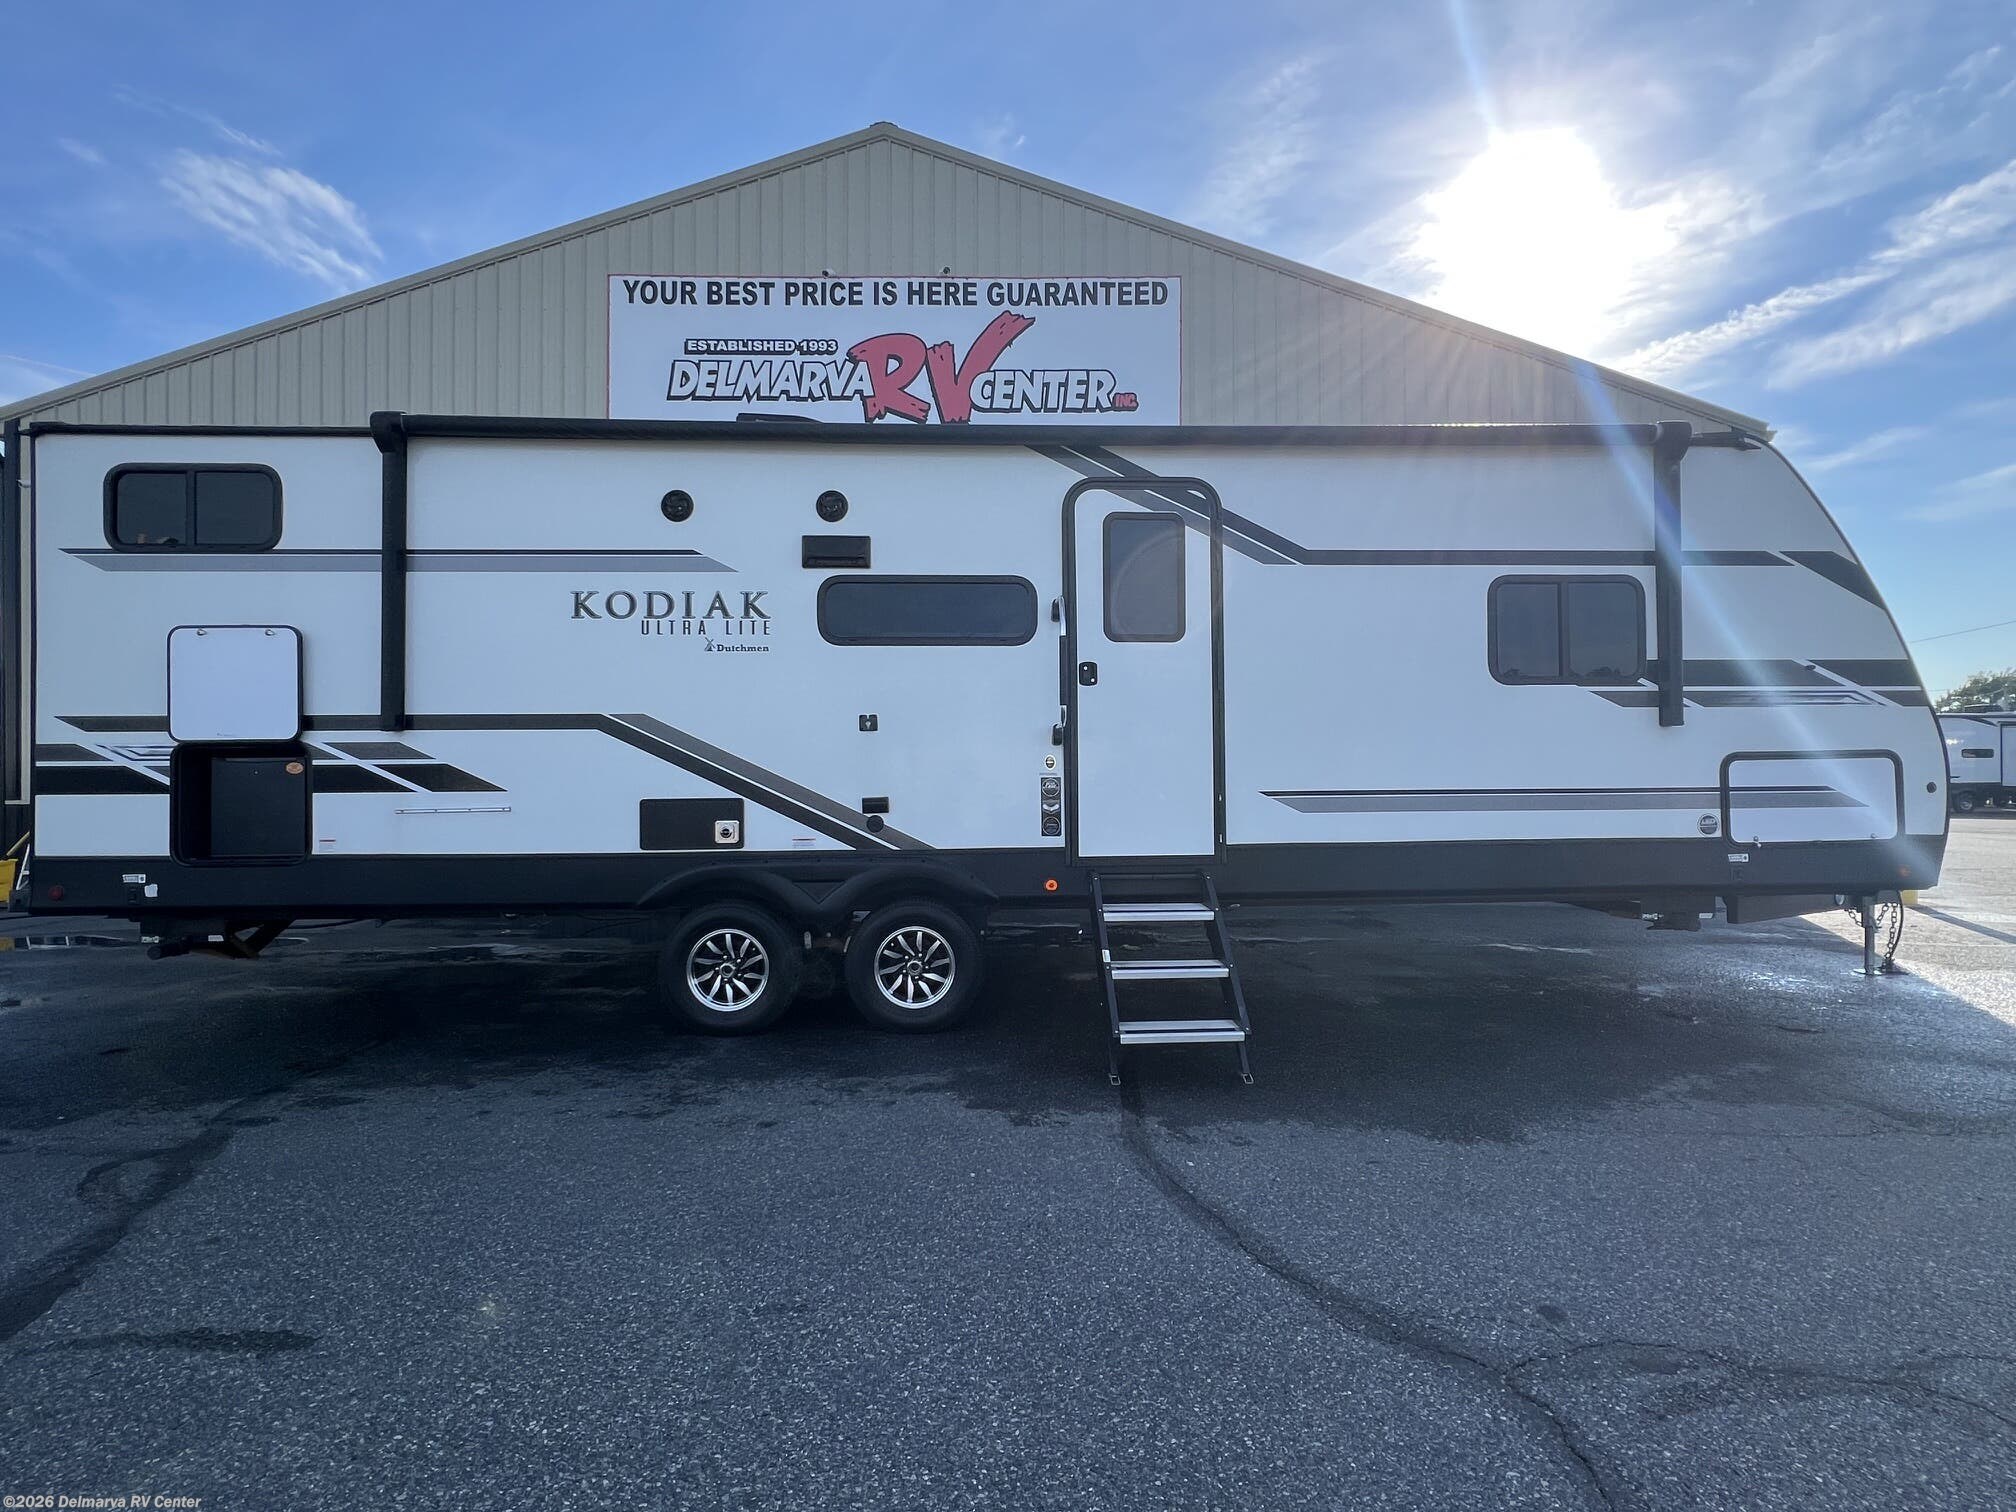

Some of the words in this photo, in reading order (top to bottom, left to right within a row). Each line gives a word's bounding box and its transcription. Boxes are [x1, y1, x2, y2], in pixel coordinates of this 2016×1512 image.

[623, 280, 698, 305] YOUR
[707, 281, 775, 306] BEST
[785, 282, 863, 306] PRICE
[874, 282, 898, 306] IS
[908, 282, 978, 306] HERE
[987, 282, 1169, 307] GUARANTEED
[686, 339, 796, 354] ESTABLISHED
[800, 340, 839, 354] 1993
[667, 360, 875, 402] DELMARVA
[847, 310, 1036, 424] RV
[969, 369, 1117, 412] CENTER
[570, 590, 772, 620] KODIAK
[641, 620, 707, 636] ULTRA
[725, 620, 771, 636] LITE
[716, 644, 770, 652] Dutchmen
